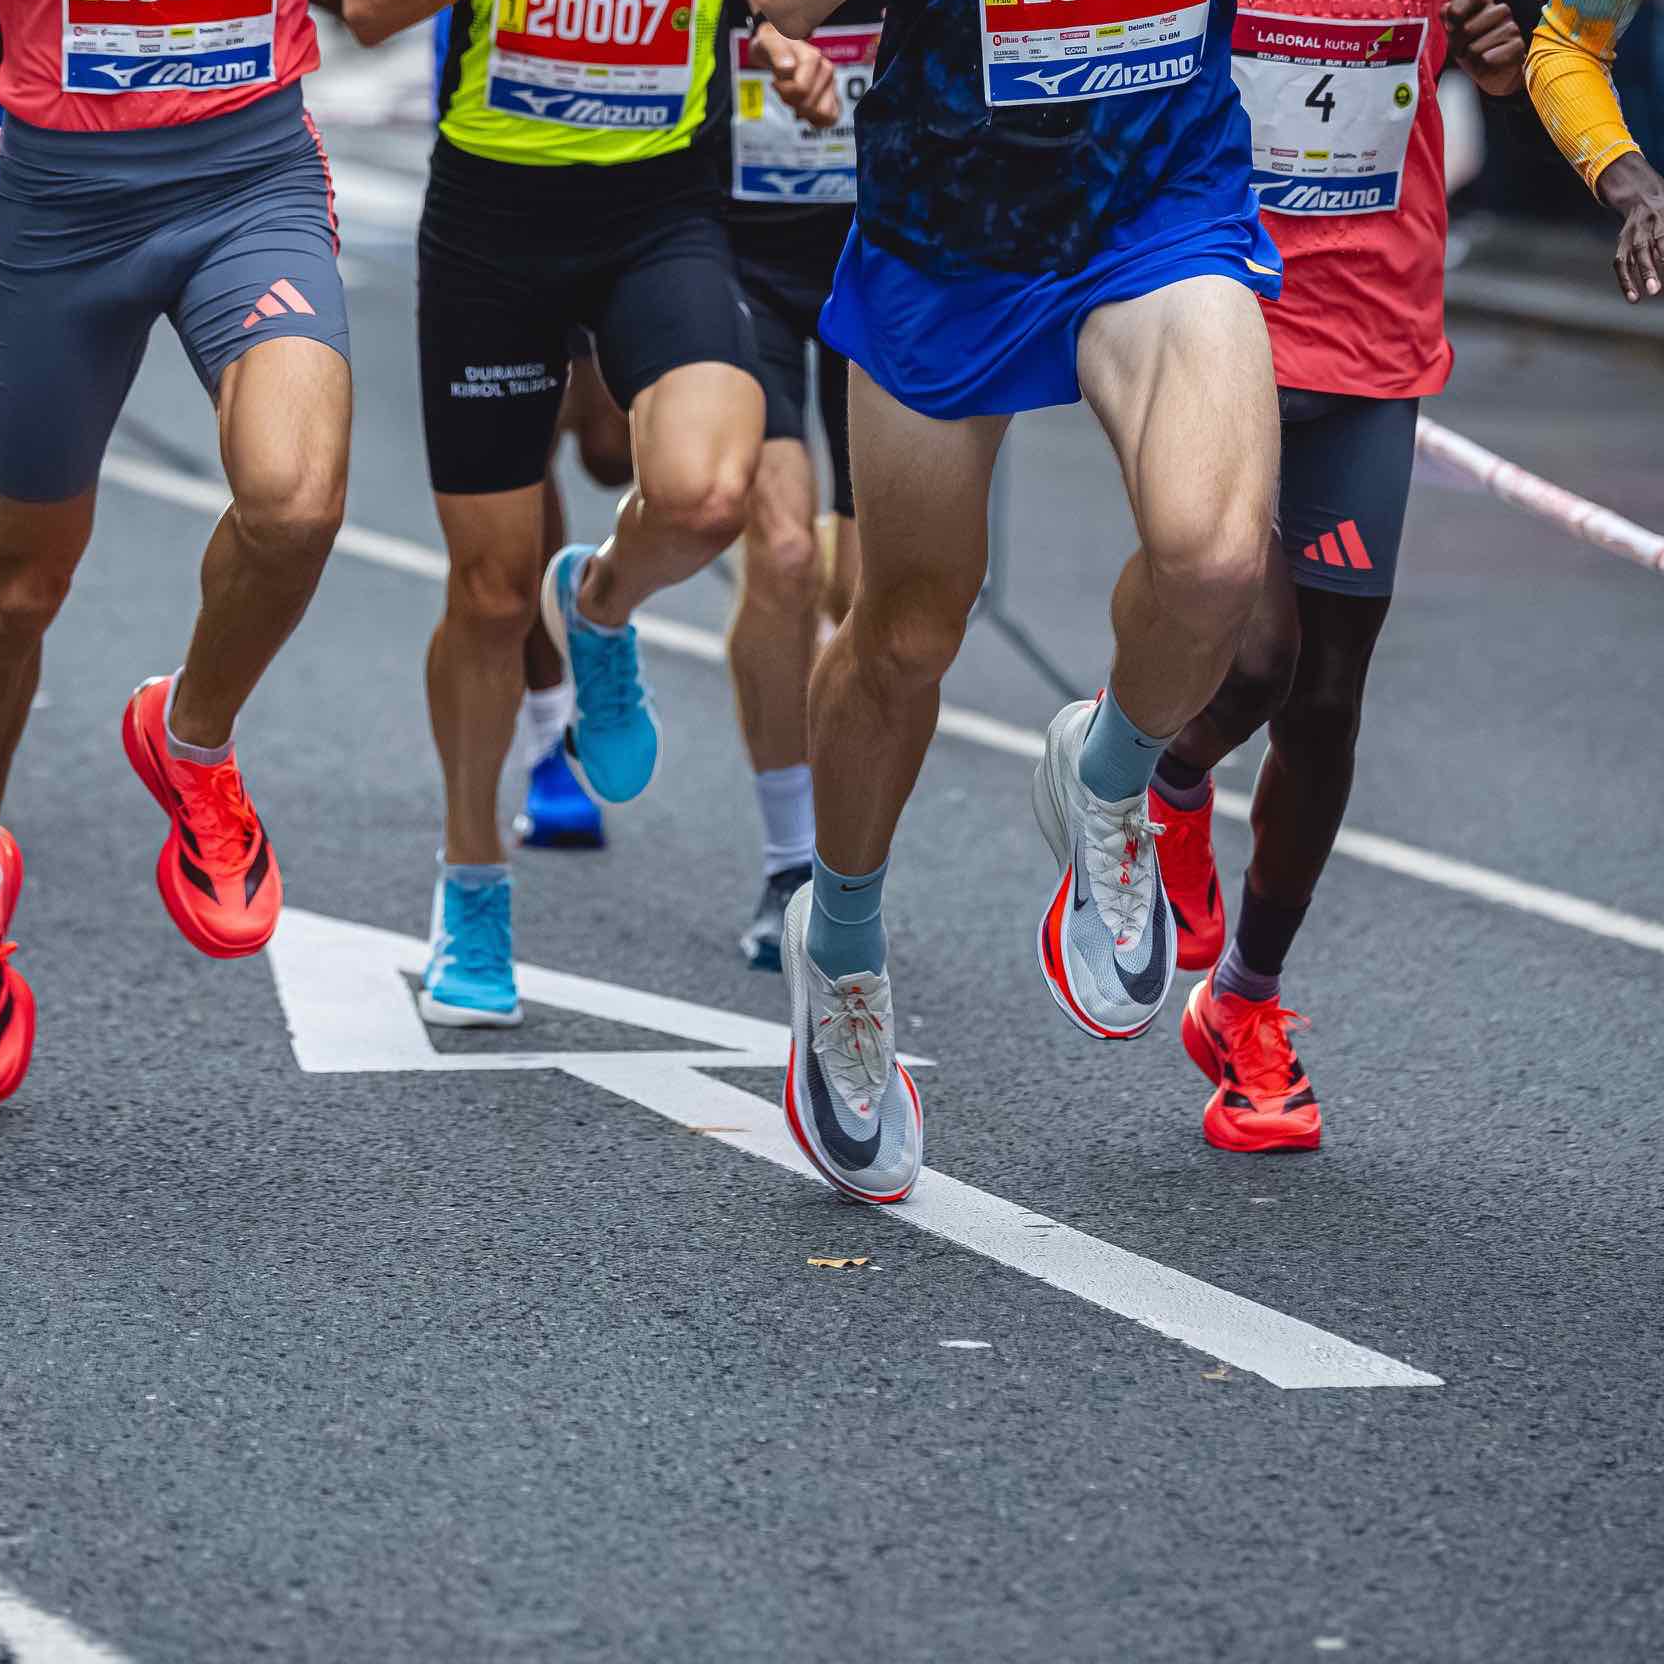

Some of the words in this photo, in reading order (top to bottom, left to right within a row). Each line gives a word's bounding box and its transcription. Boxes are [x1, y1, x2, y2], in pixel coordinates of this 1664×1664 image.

[1128, 22, 1154, 32] Deloitte
[1257, 31, 1321, 48] LABORAL
[1324, 38, 1360, 51] kutxa
[1305, 74, 1335, 123] 4
